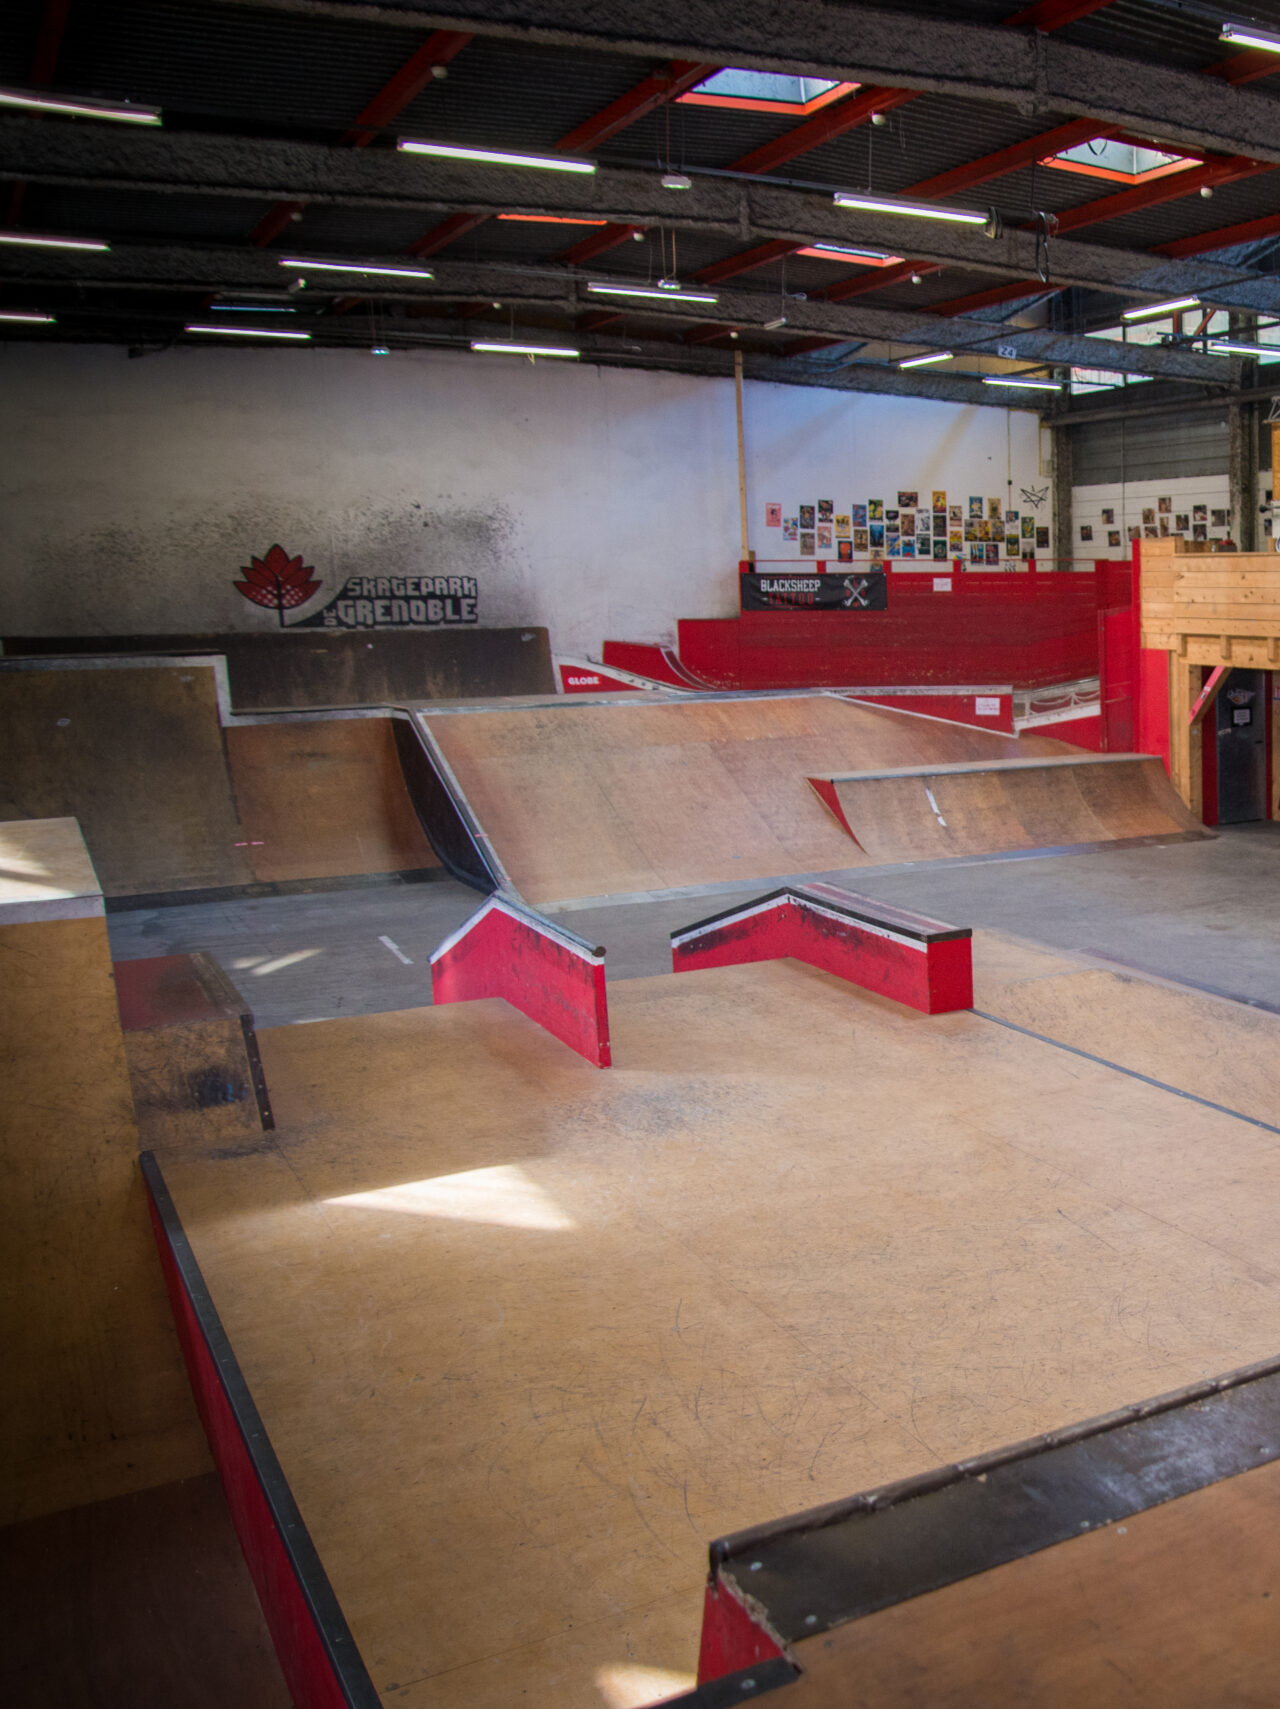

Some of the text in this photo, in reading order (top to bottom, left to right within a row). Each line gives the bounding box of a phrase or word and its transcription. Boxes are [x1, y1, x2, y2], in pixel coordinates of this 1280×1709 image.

[347, 577, 477, 597] SKATEPARK
[760, 579, 821, 592] BLACKSHEEP
[768, 592, 814, 605] TATTOO
[323, 608, 337, 626] DE
[337, 599, 477, 626] GRENOBLE
[568, 677, 599, 685] GLOBE
